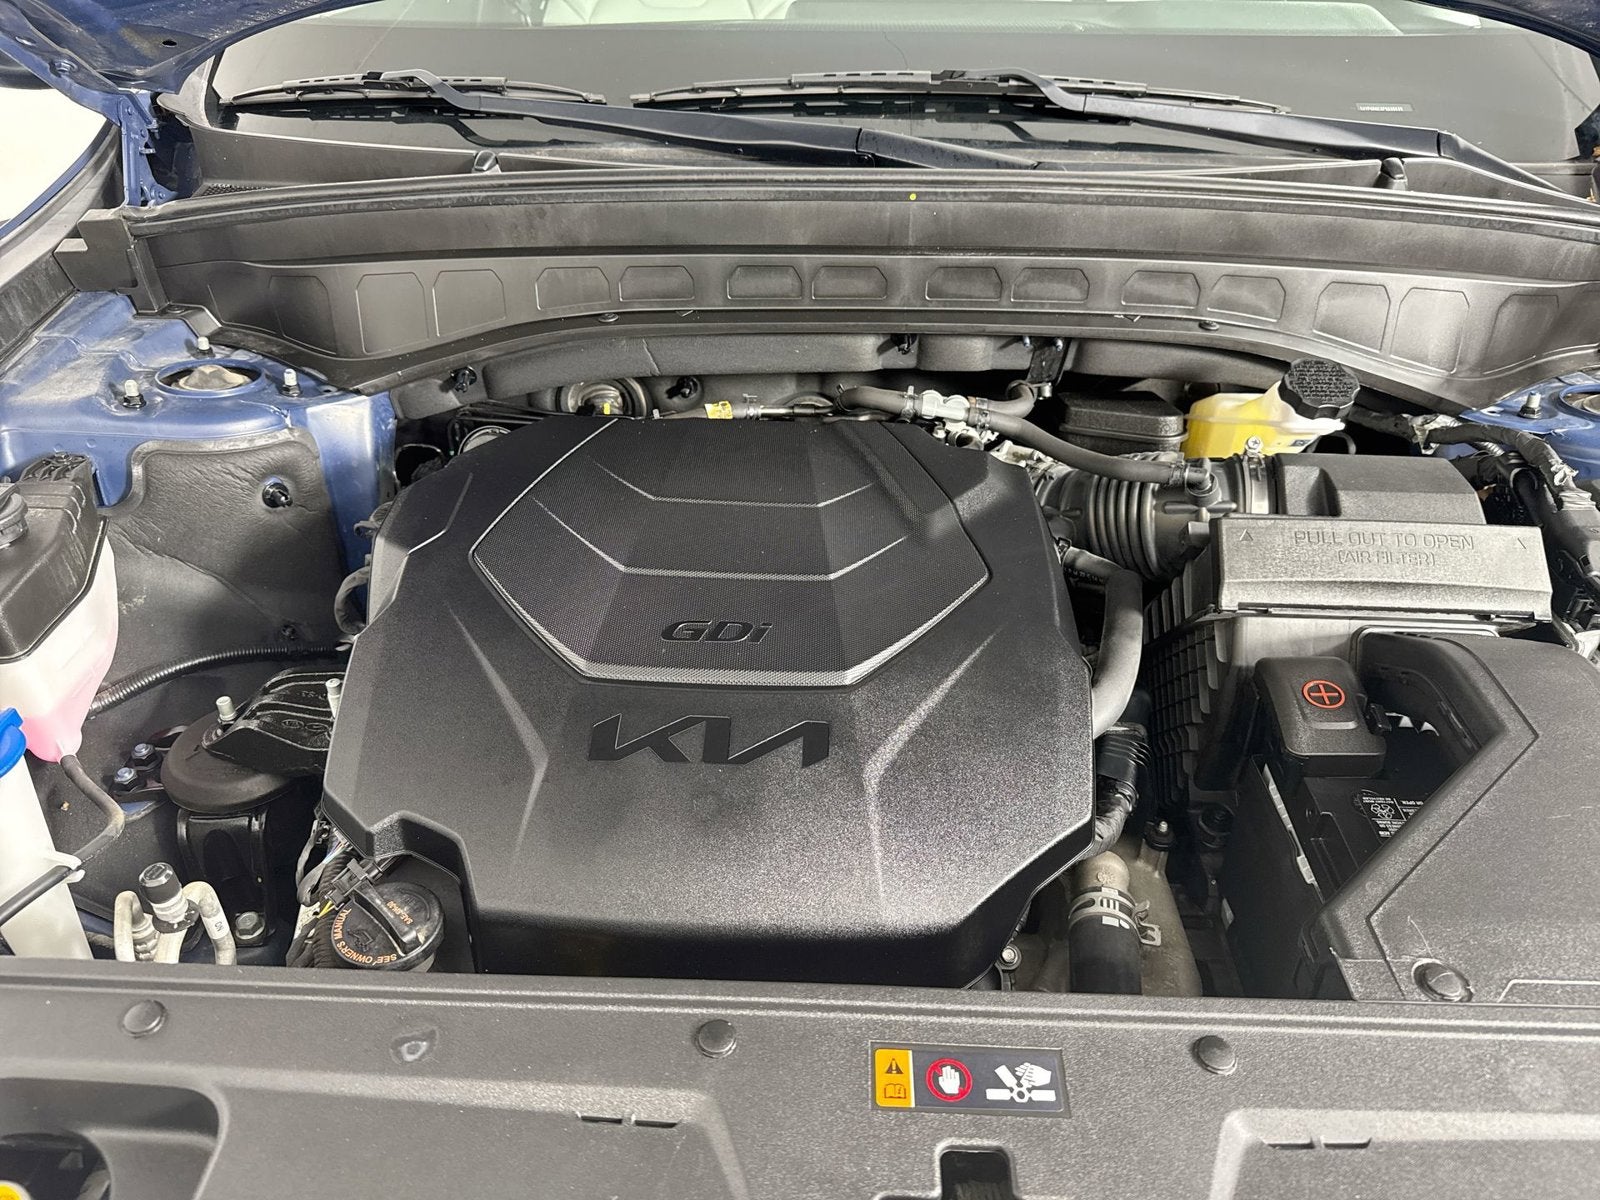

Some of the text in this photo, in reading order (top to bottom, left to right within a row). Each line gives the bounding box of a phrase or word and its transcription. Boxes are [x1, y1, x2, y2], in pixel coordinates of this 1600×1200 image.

[1294, 530, 1475, 550] PULL OUT TO OPEN
[1338, 550, 1371, 564] (AIR
[660, 620, 774, 645] GDi
[588, 713, 831, 769] KIA
[333, 908, 352, 940] MANUAL
[376, 953, 397, 964] SEE
